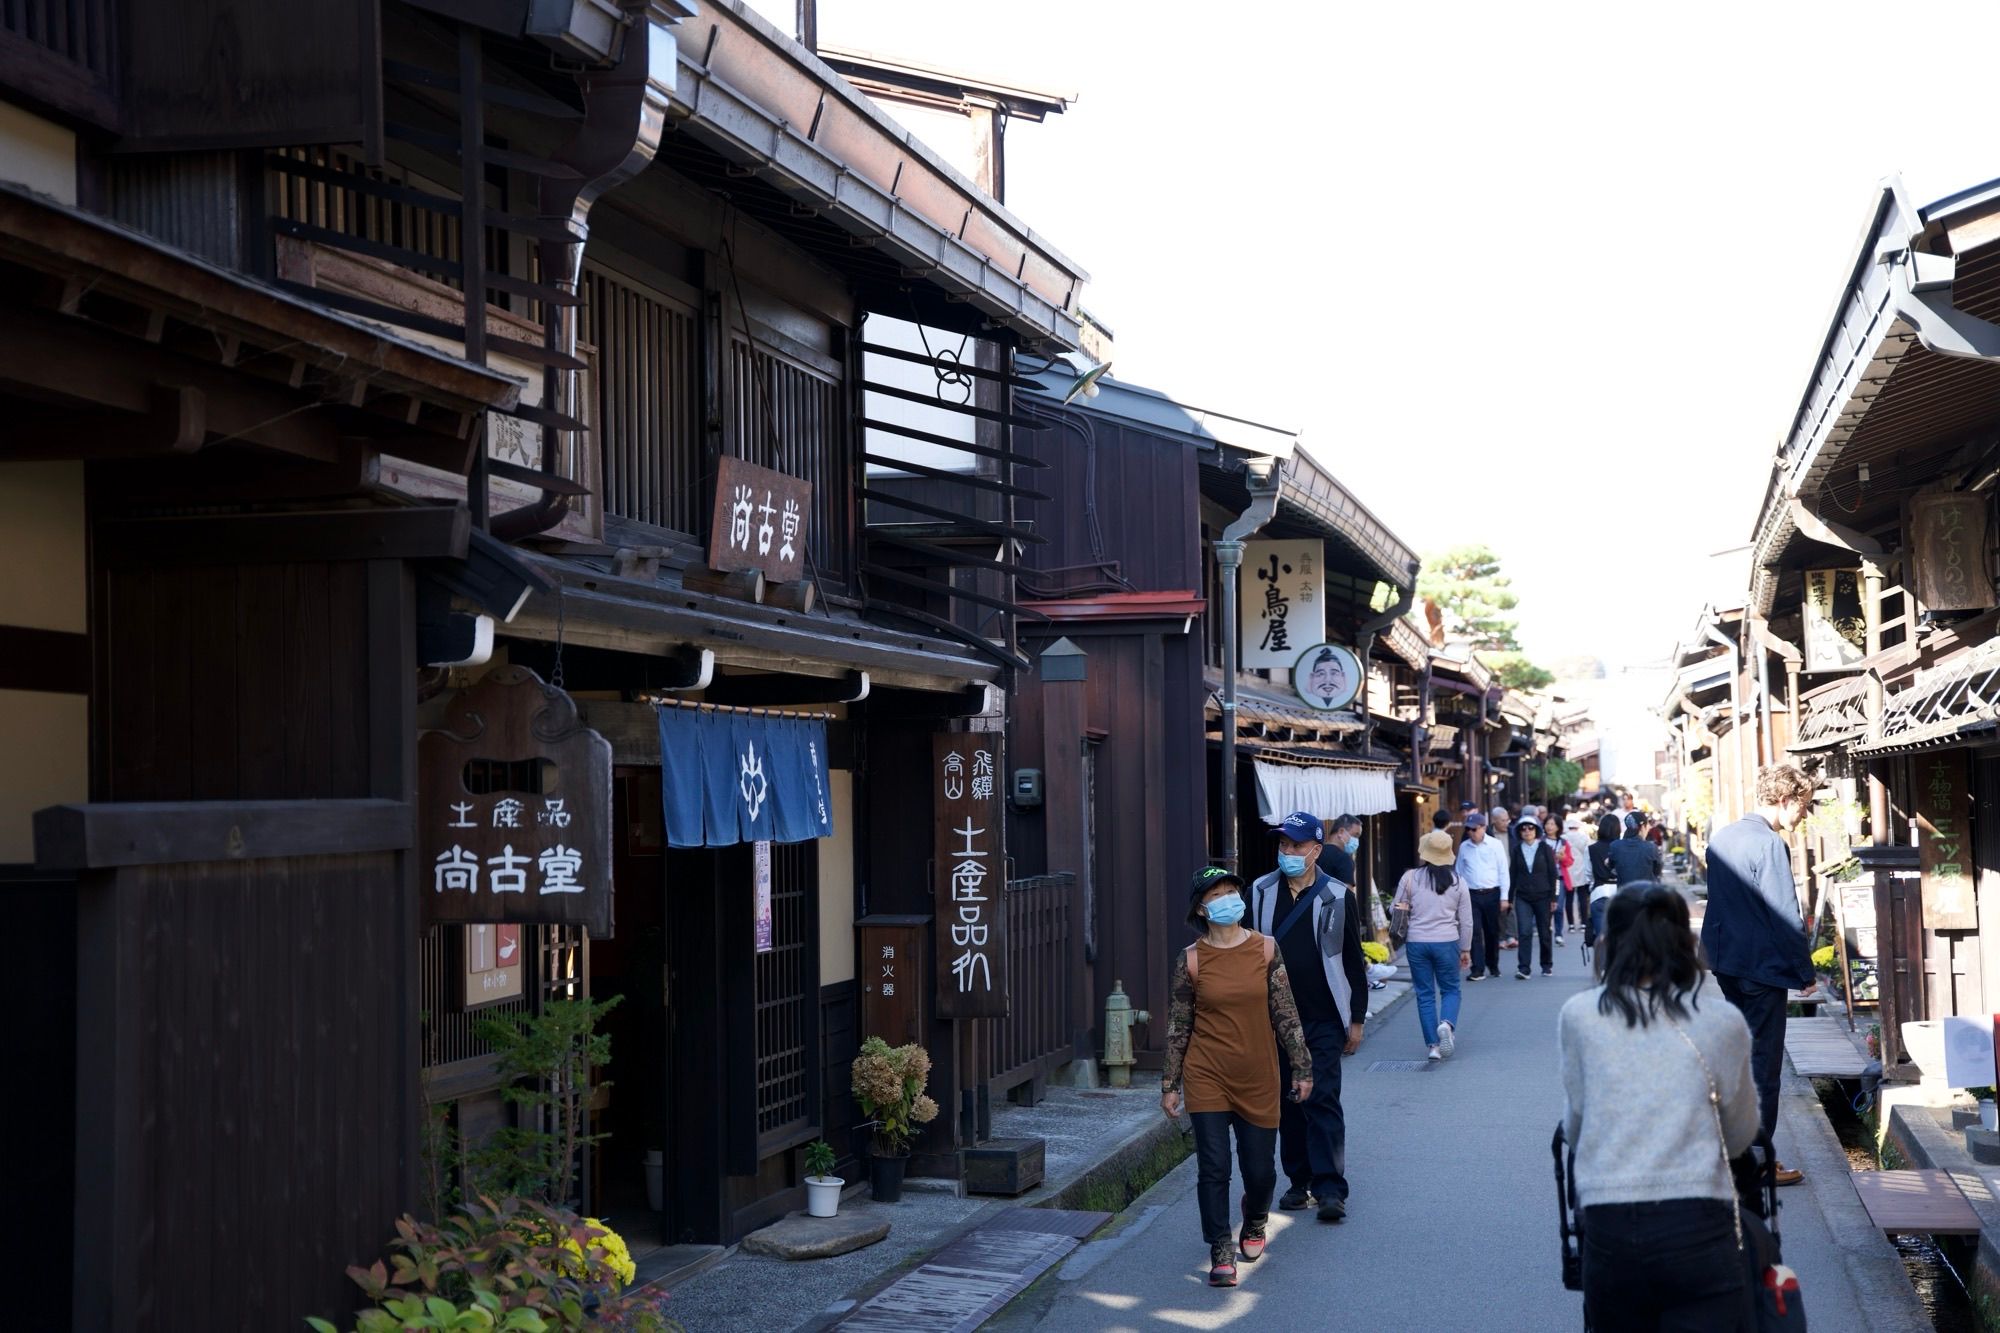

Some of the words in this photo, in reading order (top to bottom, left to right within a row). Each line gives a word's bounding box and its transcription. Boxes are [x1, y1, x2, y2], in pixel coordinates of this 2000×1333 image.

[731, 484, 800, 563] 尚古堂
[1257, 554, 1292, 652] 小鳥屋
[942, 751, 966, 800] 高山
[1928, 760, 1952, 811] 古物商
[448, 797, 572, 829] 土産品
[434, 844, 586, 895] 尚古堂
[882, 945, 895, 996] 消火器
